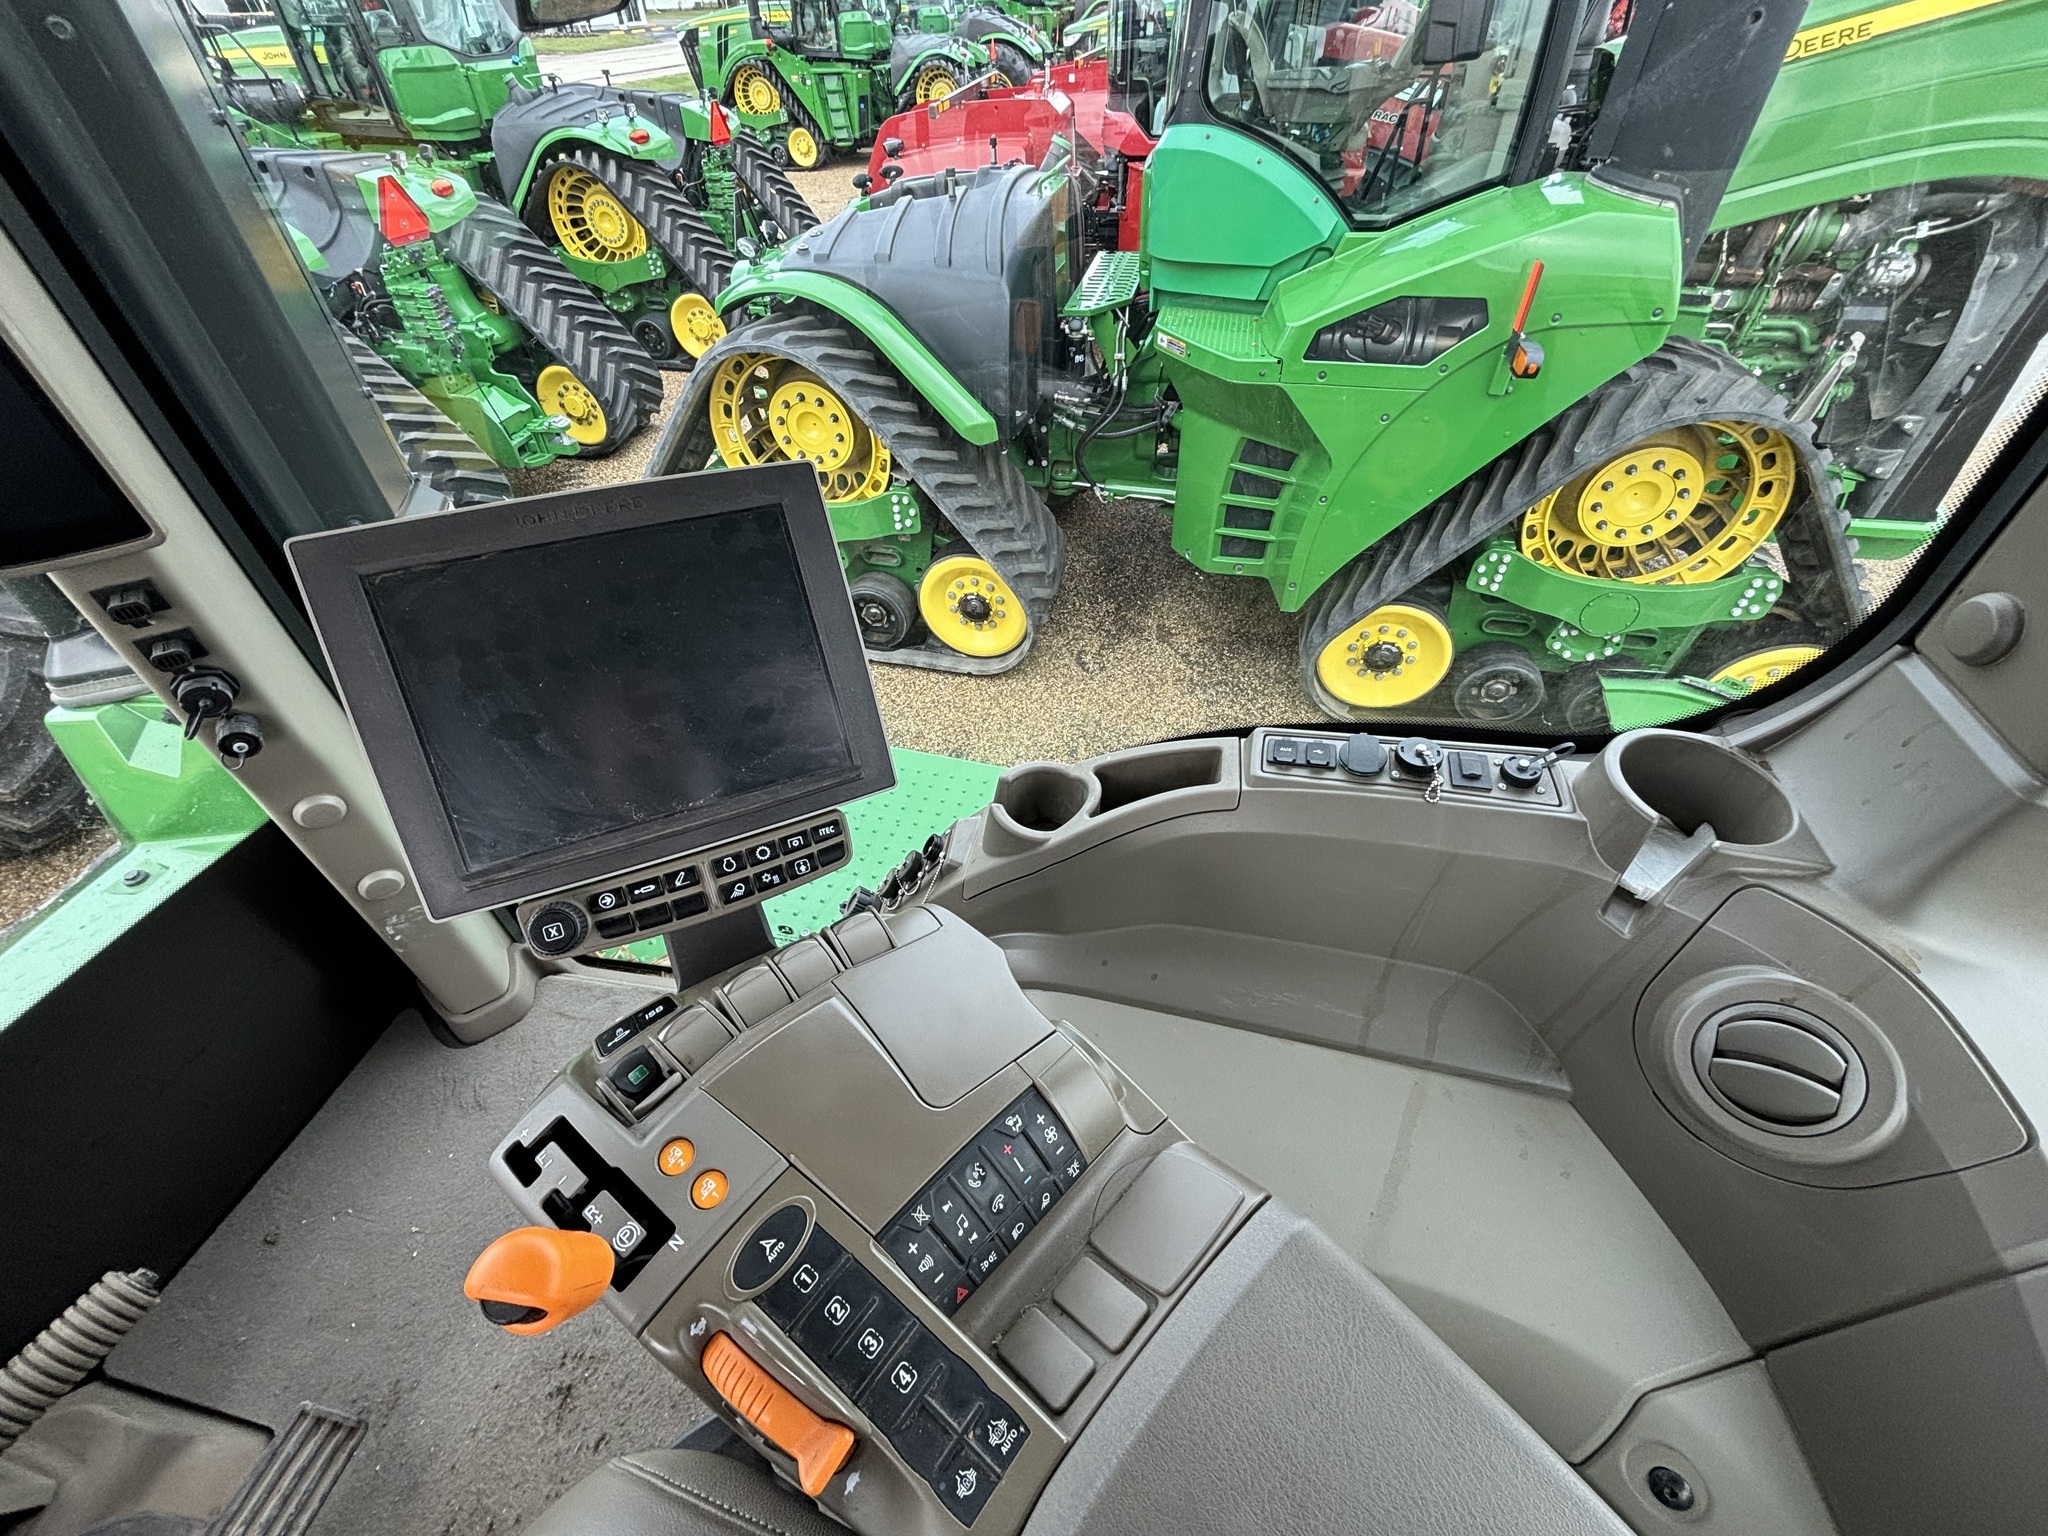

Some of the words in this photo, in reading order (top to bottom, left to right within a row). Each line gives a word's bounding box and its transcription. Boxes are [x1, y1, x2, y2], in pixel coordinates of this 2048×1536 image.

[1784, 20, 1874, 58] DEERE
[262, 51, 288, 60] JOHN
[514, 508, 570, 526] JOHN
[572, 495, 646, 520] DEERE
[818, 825, 835, 837] ITEC
[535, 1149, 548, 1165] F
[677, 1158, 687, 1167] 2
[711, 1190, 721, 1198] 1
[583, 1204, 600, 1221] R
[668, 1233, 685, 1252] N
[767, 1241, 785, 1263] AUTO
[800, 1272, 813, 1284] 1
[831, 1303, 846, 1319] 2
[864, 1335, 878, 1351] 3
[898, 1369, 912, 1386] 4
[1000, 1428, 1018, 1456] AUTO
